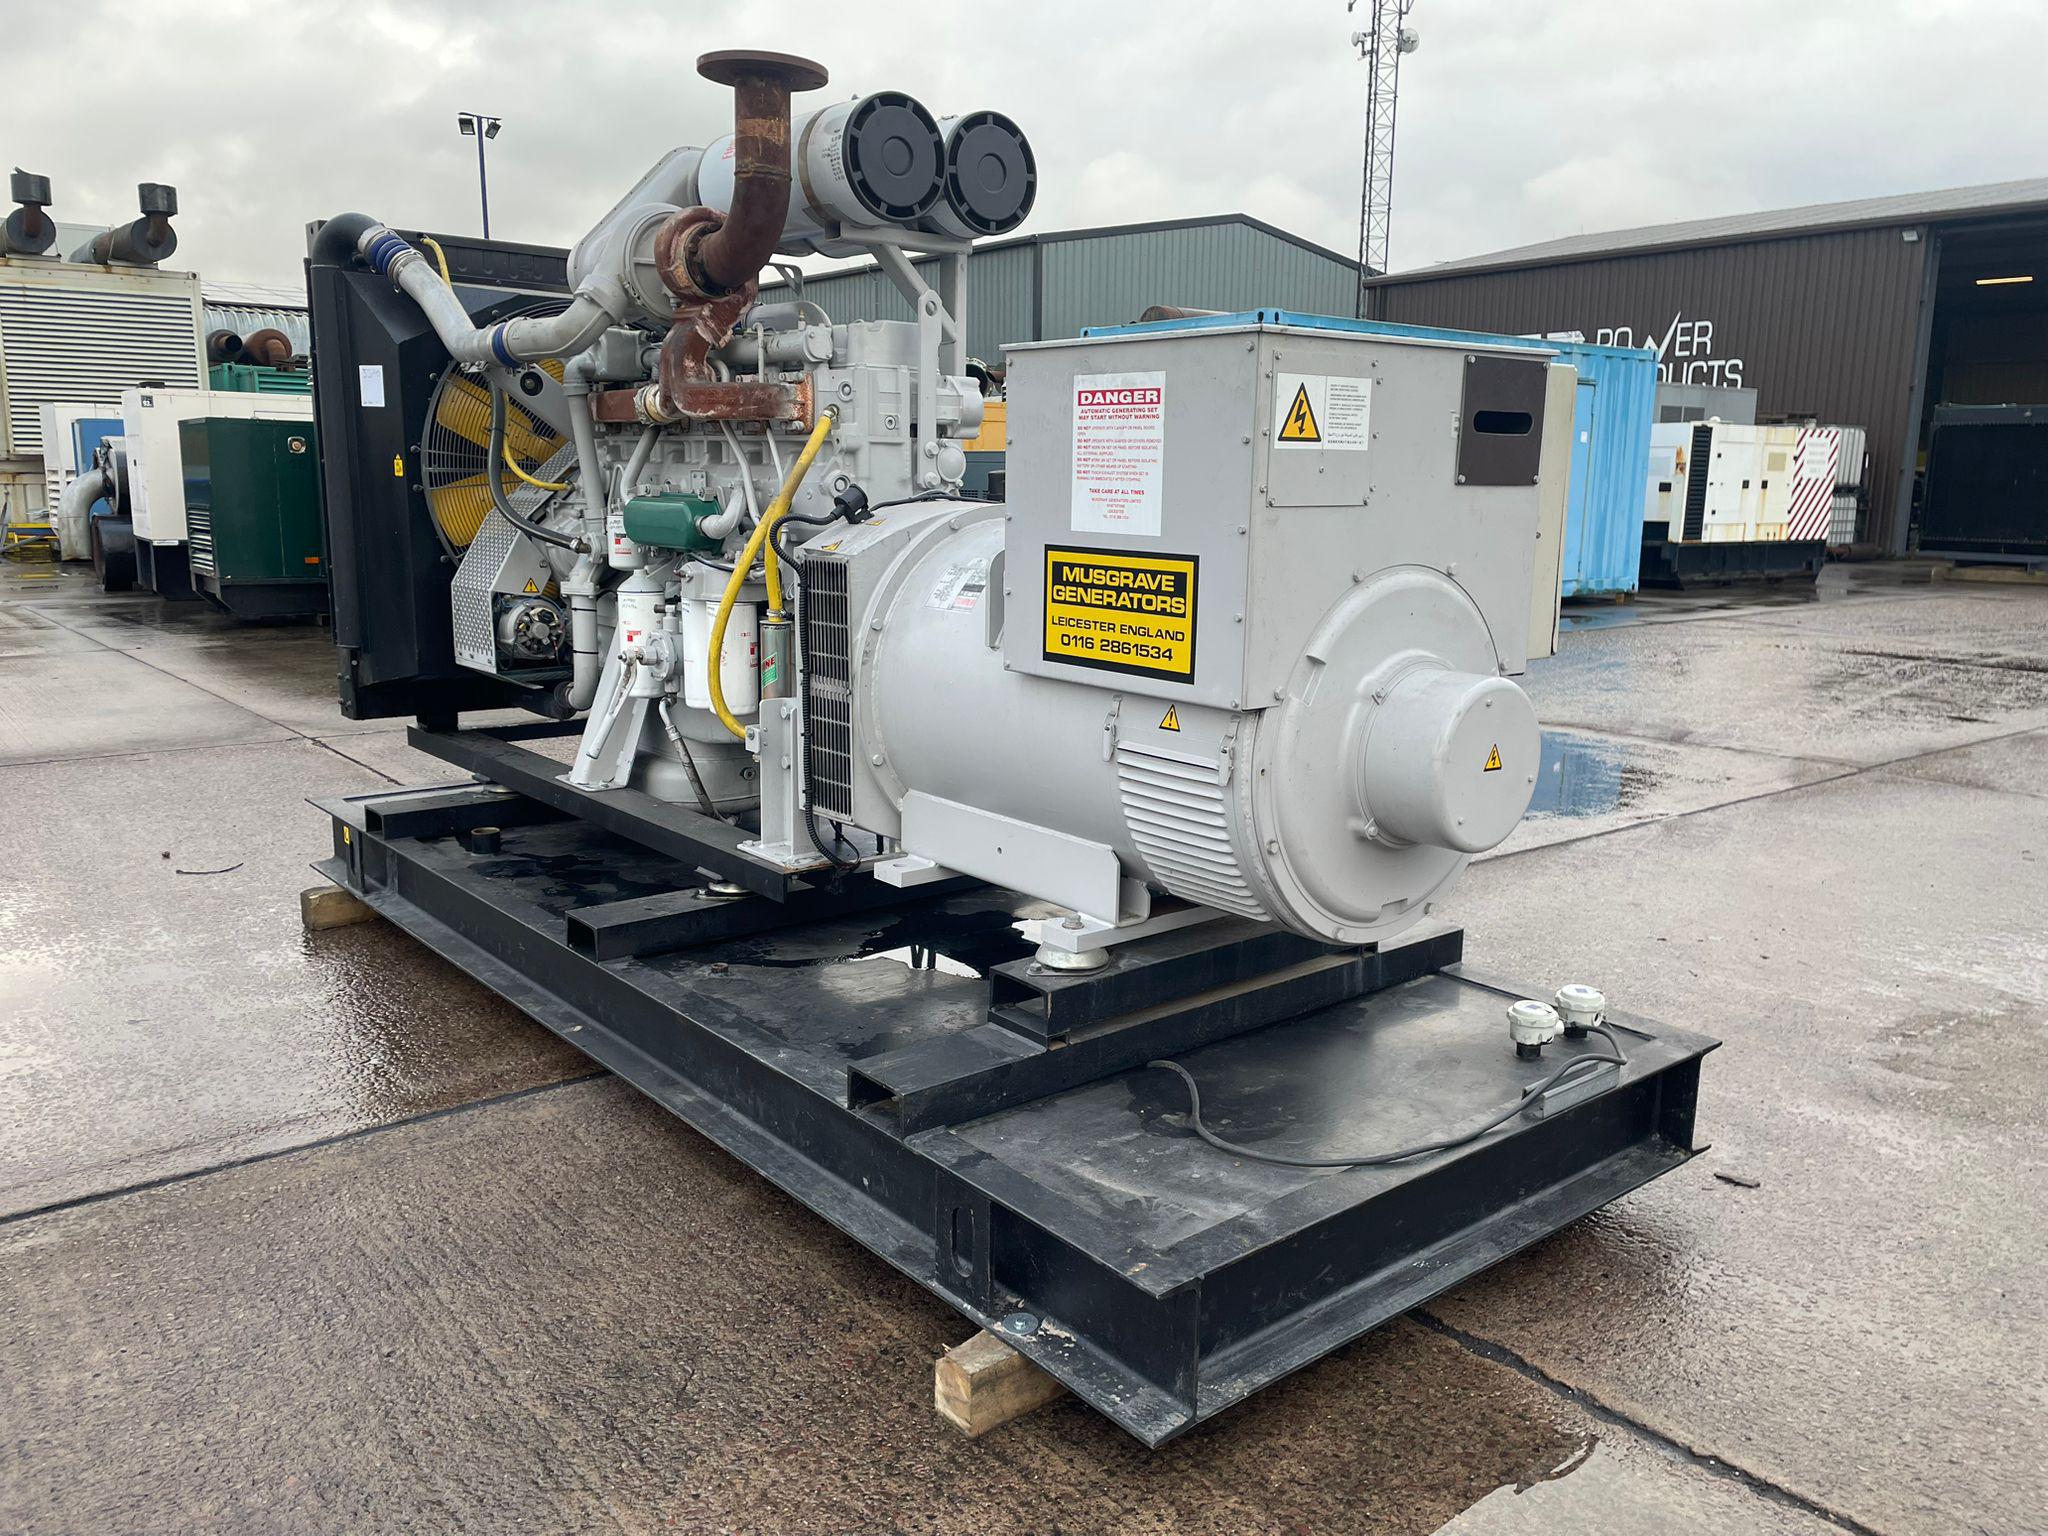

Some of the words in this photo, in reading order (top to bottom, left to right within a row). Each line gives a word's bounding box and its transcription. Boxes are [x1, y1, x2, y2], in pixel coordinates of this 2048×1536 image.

[1080, 390, 1159, 405] DANGER
[1062, 565, 1175, 592] MUSGRAVE
[1052, 584, 1186, 614] GENERATORS
[1051, 615, 1116, 633] LEICESTER
[1120, 624, 1185, 642] ENGLAND
[1061, 633, 1095, 649] 0116
[1100, 638, 1173, 661] 2861534
